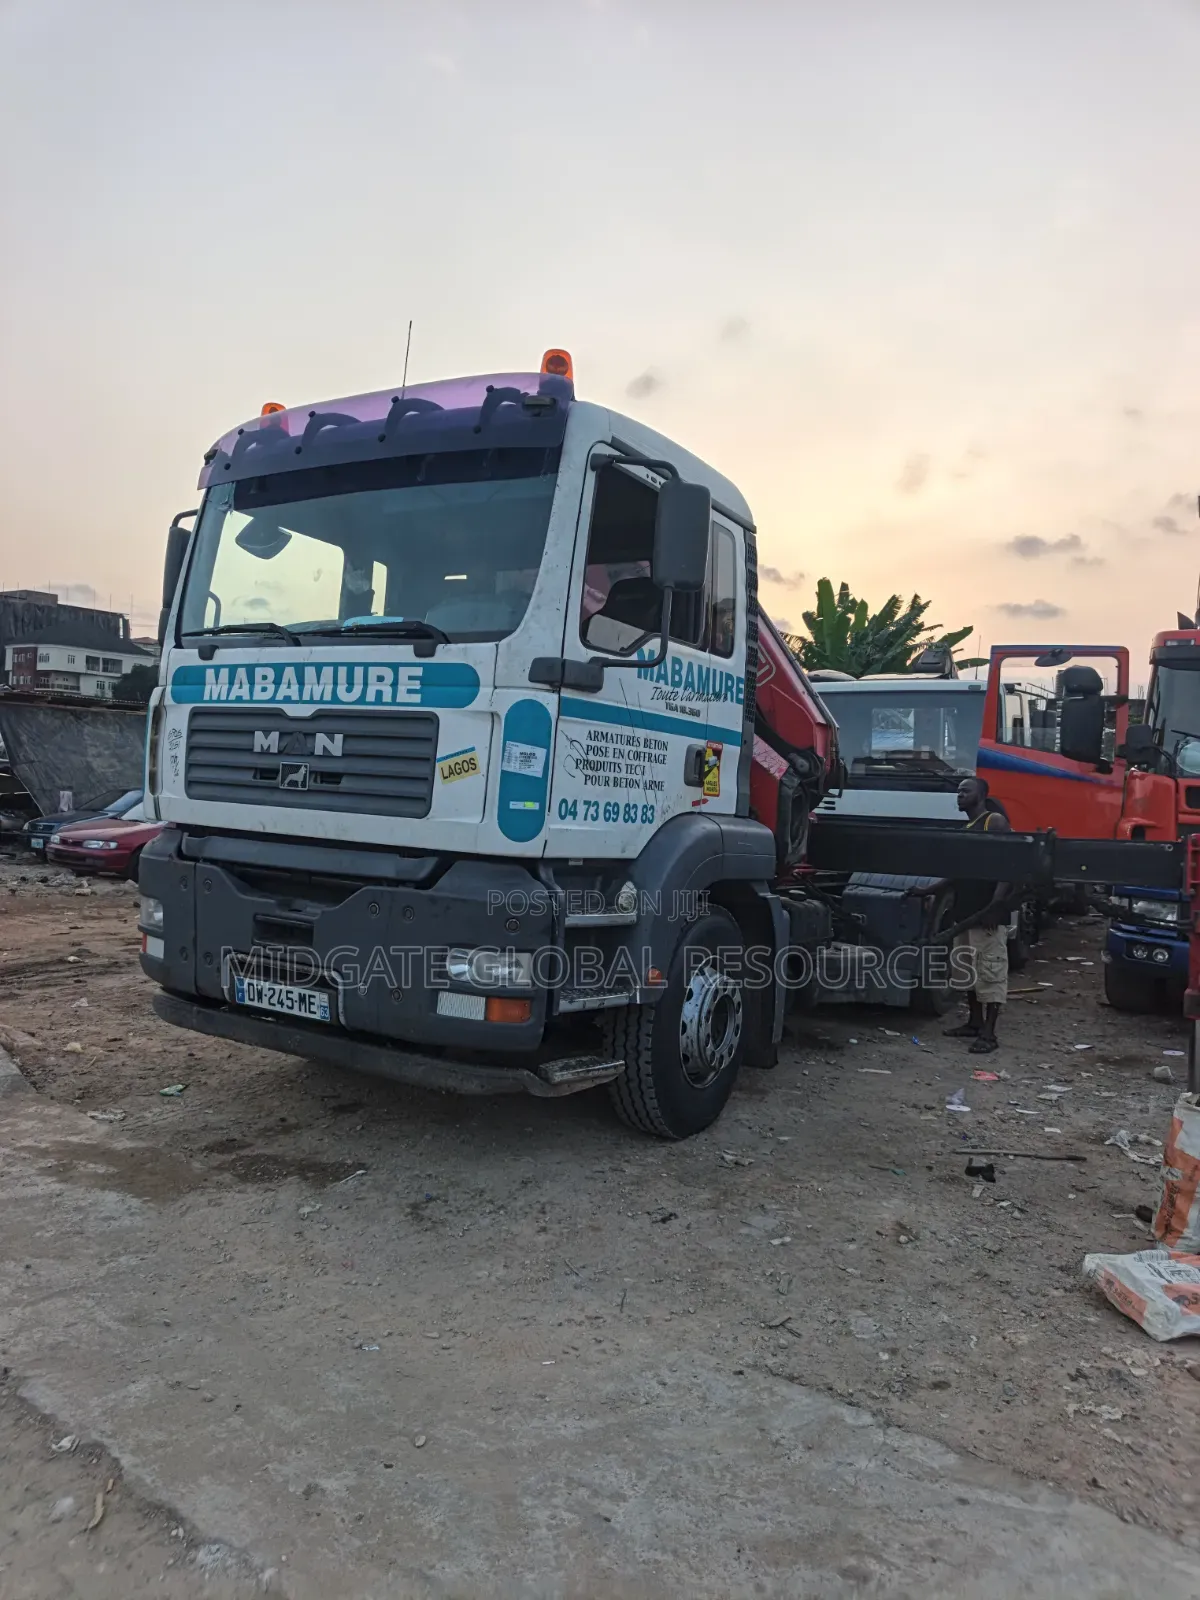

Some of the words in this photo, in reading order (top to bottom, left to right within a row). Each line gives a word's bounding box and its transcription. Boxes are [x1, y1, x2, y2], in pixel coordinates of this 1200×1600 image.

[203, 666, 423, 703] MABAMURE
[637, 647, 744, 705] MABAMURE
[650, 686, 680, 701] Toute
[253, 730, 343, 756] MAN
[586, 730, 641, 747] ARMATURES
[643, 737, 669, 751] BETON
[575, 758, 622, 774] PRODUITS
[586, 744, 610, 758] POSE
[613, 748, 625, 760] EN
[627, 749, 668, 765] COFFRAGE
[440, 757, 477, 780] LAGOS
[584, 774, 610, 787] POUR
[613, 777, 641, 789] BETON
[643, 779, 665, 791] ARME
[558, 798, 577, 820] 04
[583, 800, 600, 821] 73
[603, 801, 620, 823] 69
[623, 803, 638, 824] 83
[641, 804, 655, 825] 83
[247, 982, 317, 1015] DW-245-ME
[320, 1006, 329, 1019] 63
